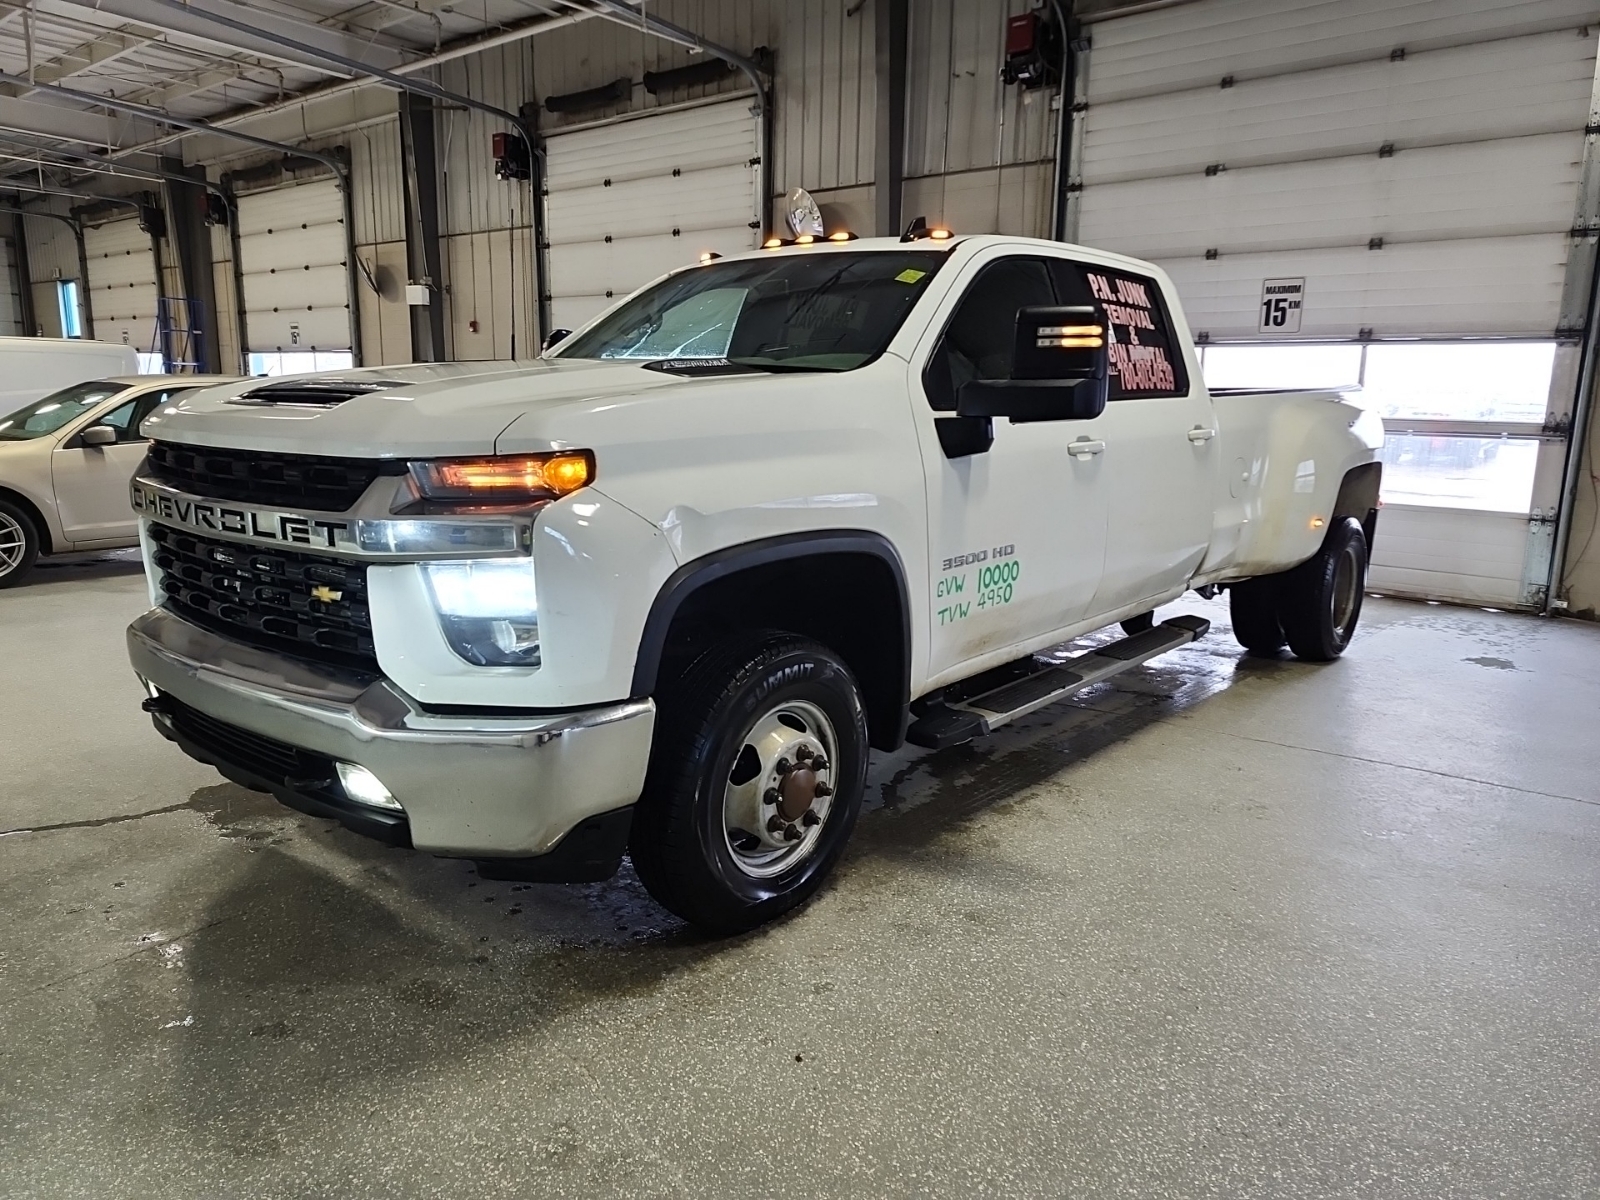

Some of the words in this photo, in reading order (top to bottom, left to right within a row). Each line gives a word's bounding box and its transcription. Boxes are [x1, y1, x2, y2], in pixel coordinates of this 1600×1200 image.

[1115, 279, 1152, 308] JUNK
[1265, 285, 1302, 295] MAXIMUM
[1102, 303, 1155, 330] REMOVAL
[1263, 299, 1288, 327] 15
[1288, 301, 1301, 309] KM
[1129, 326, 1140, 345] &
[131, 486, 348, 547] CHEVROLET
[942, 550, 988, 571] 3500
[992, 544, 1015, 559] HD
[937, 574, 966, 598] GVW
[977, 560, 1020, 594] 10000
[937, 601, 971, 626] TVW
[977, 582, 1013, 610] 4950
[745, 663, 815, 713] SUMMIT
